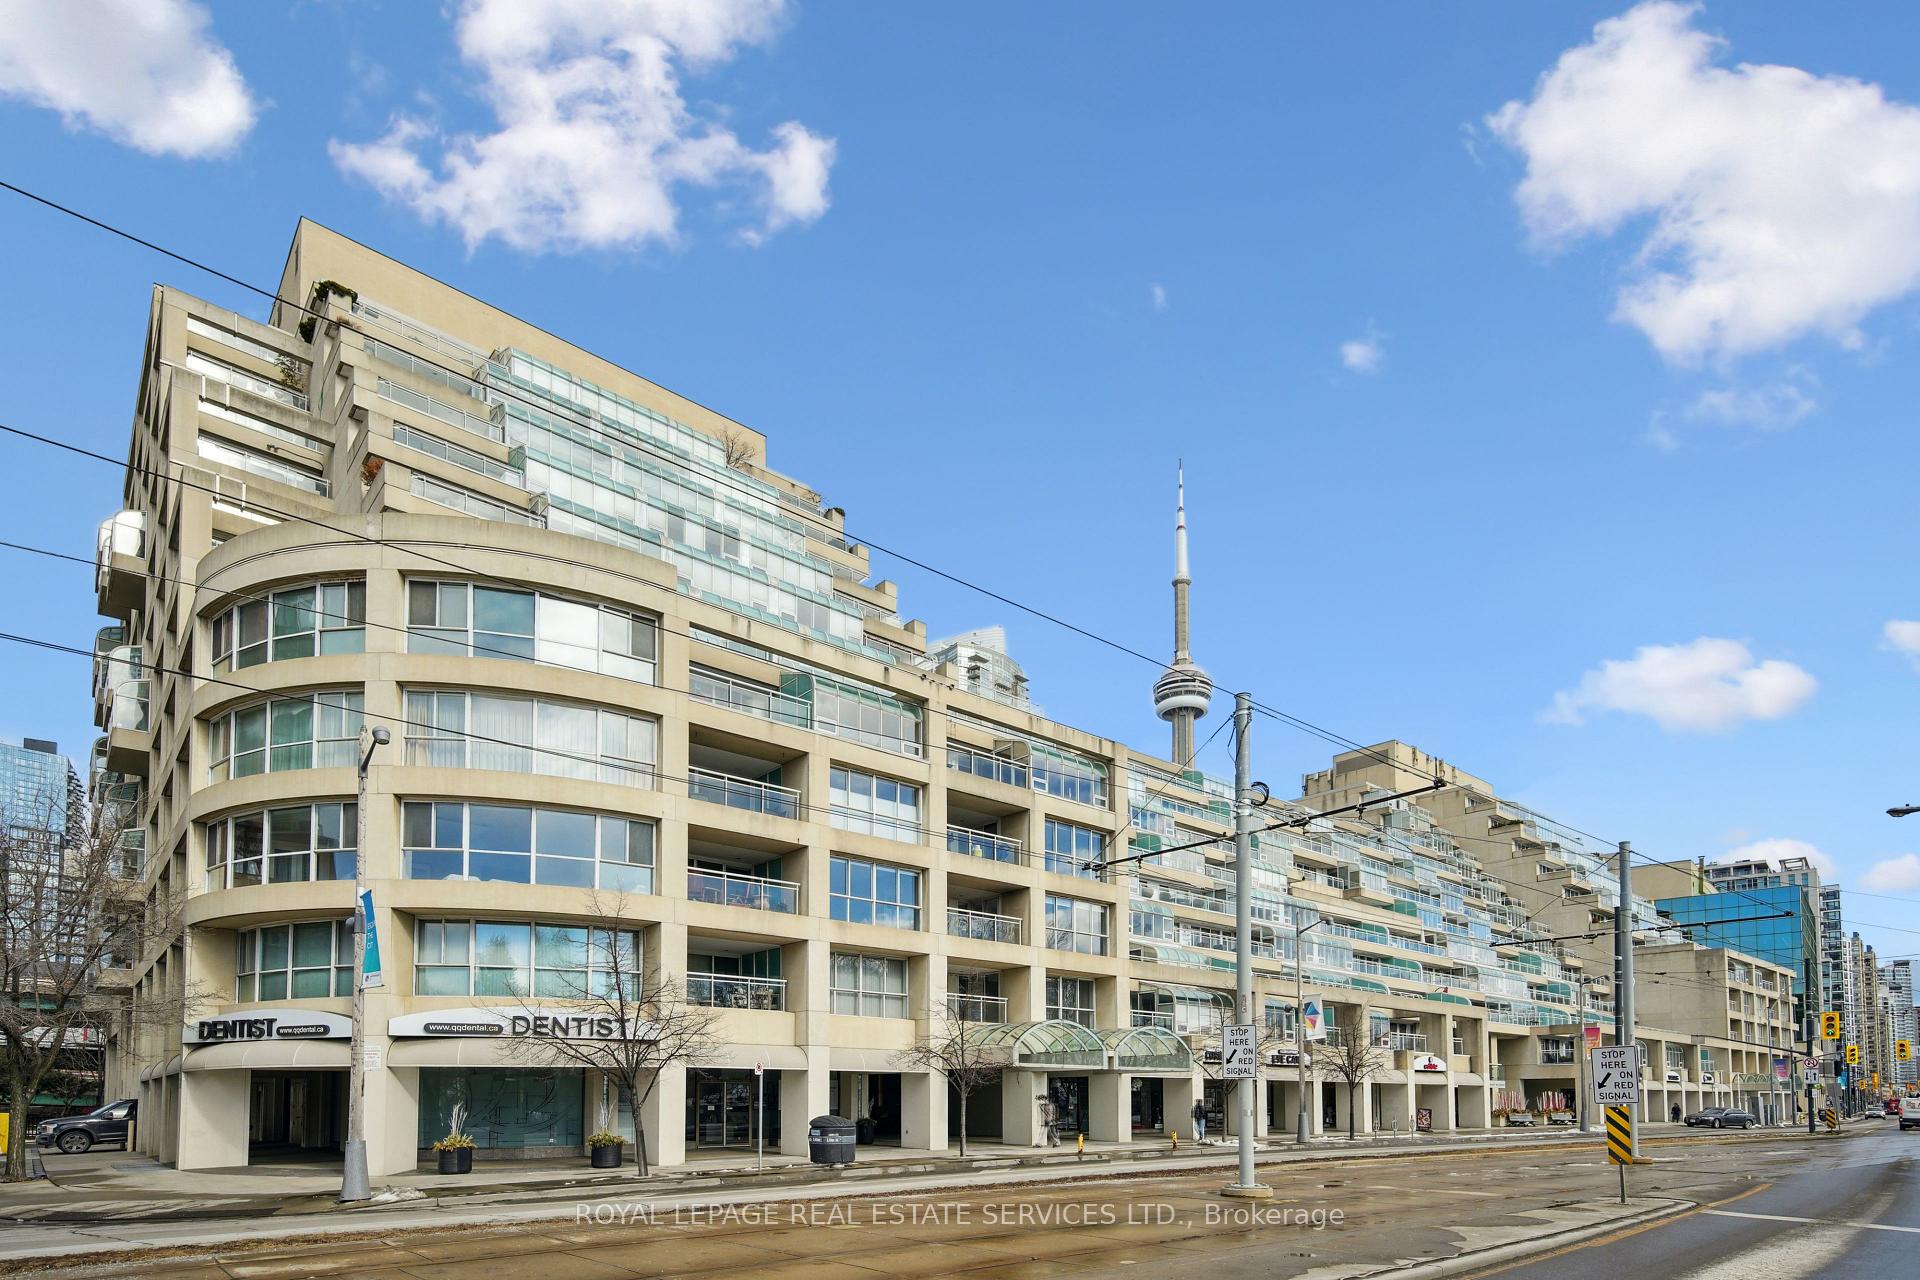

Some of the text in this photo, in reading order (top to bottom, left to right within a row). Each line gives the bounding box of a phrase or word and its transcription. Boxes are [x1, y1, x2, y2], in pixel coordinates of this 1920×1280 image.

[198, 1018, 277, 1040] DENTIST
[429, 1024, 499, 1033] www.qqdental.ca
[512, 1015, 630, 1037] DENTIST
[279, 1026, 324, 1035] www.qqdental.ca
[1230, 1029, 1249, 1037] STOP
[1601, 1050, 1626, 1059] STOP
[1238, 1057, 1254, 1065] RED
[1601, 1061, 1627, 1069] HERE
[1226, 1067, 1253, 1075] SIGNAL
[1619, 1071, 1633, 1079] ON
[1614, 1081, 1634, 1089] RED
[1599, 1092, 1635, 1100] SIGNAL
